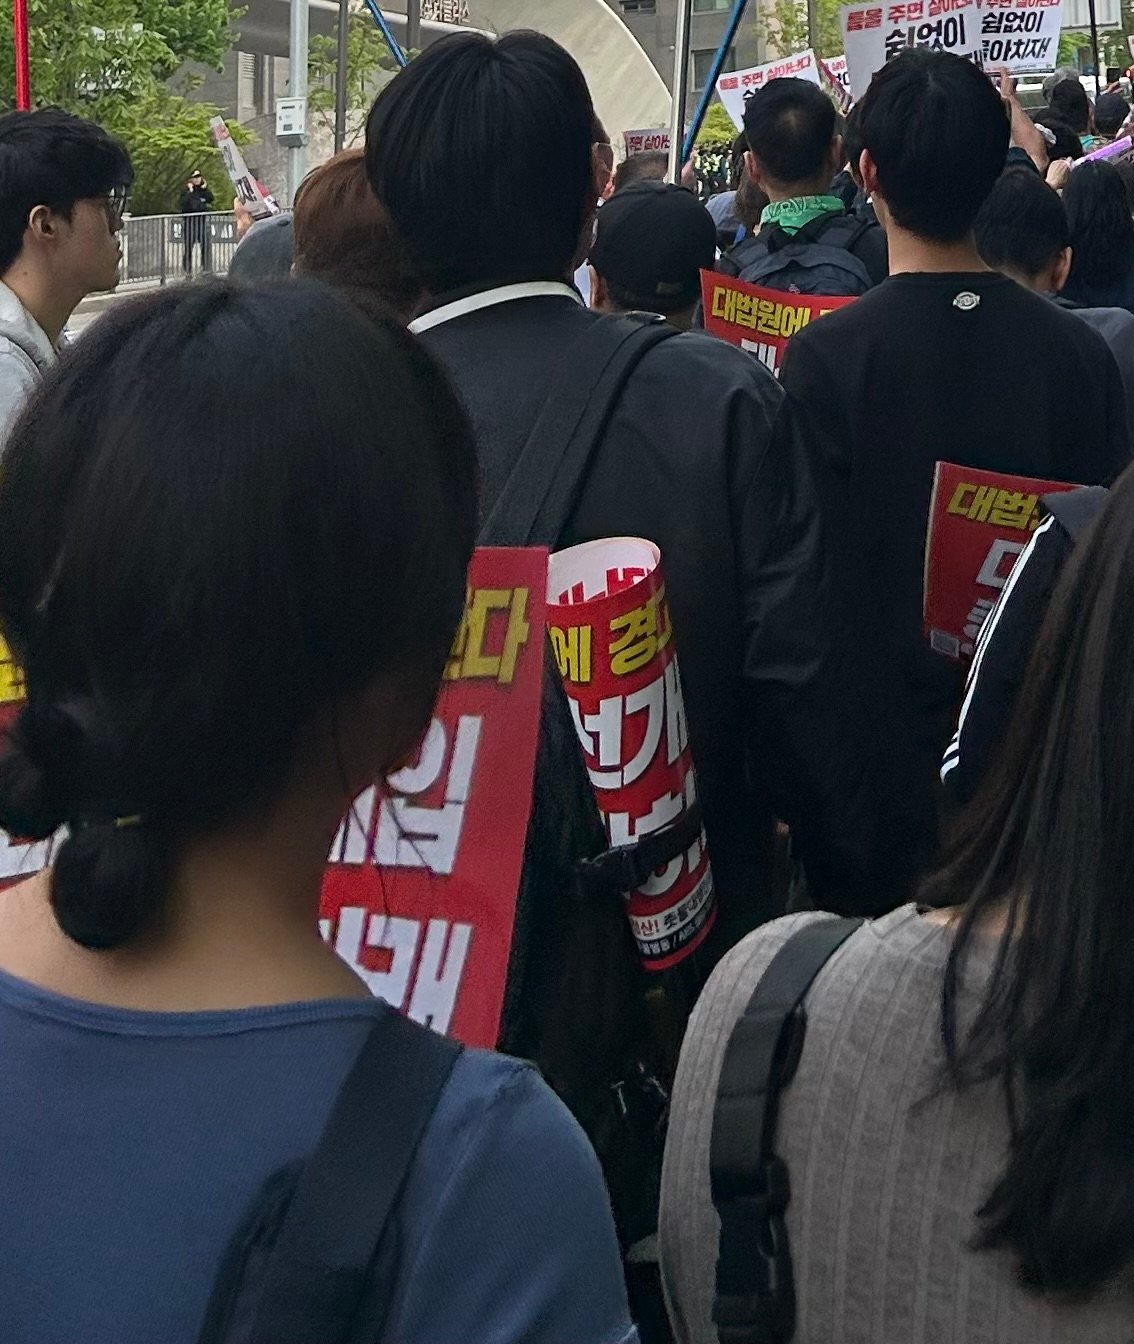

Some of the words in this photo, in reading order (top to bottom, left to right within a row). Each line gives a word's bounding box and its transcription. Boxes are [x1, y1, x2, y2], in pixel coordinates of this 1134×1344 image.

[888, 0, 924, 22] 주면
[981, 10, 1046, 36] 쉼없이
[711, 285, 812, 339] 대법원에
[947, 481, 1043, 532] 대법
